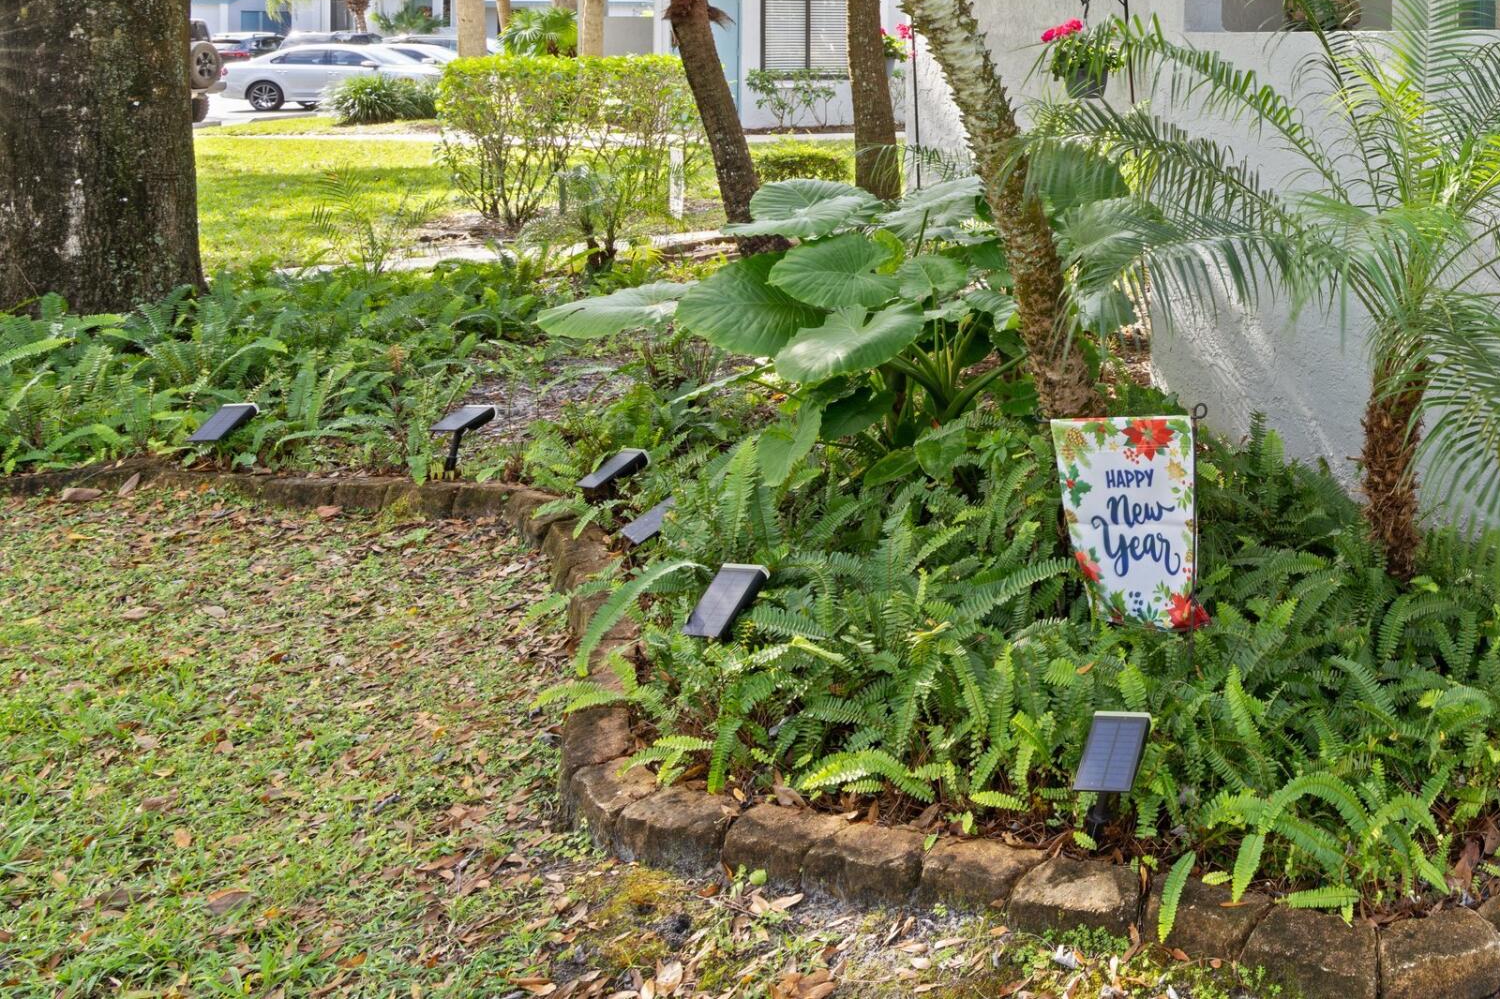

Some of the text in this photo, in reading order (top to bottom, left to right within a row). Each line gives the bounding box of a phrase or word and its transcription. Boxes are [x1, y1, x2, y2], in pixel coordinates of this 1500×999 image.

[1105, 468, 1155, 489] HAPPY
[1106, 494, 1176, 528] New
[1090, 515, 1181, 577] Year
